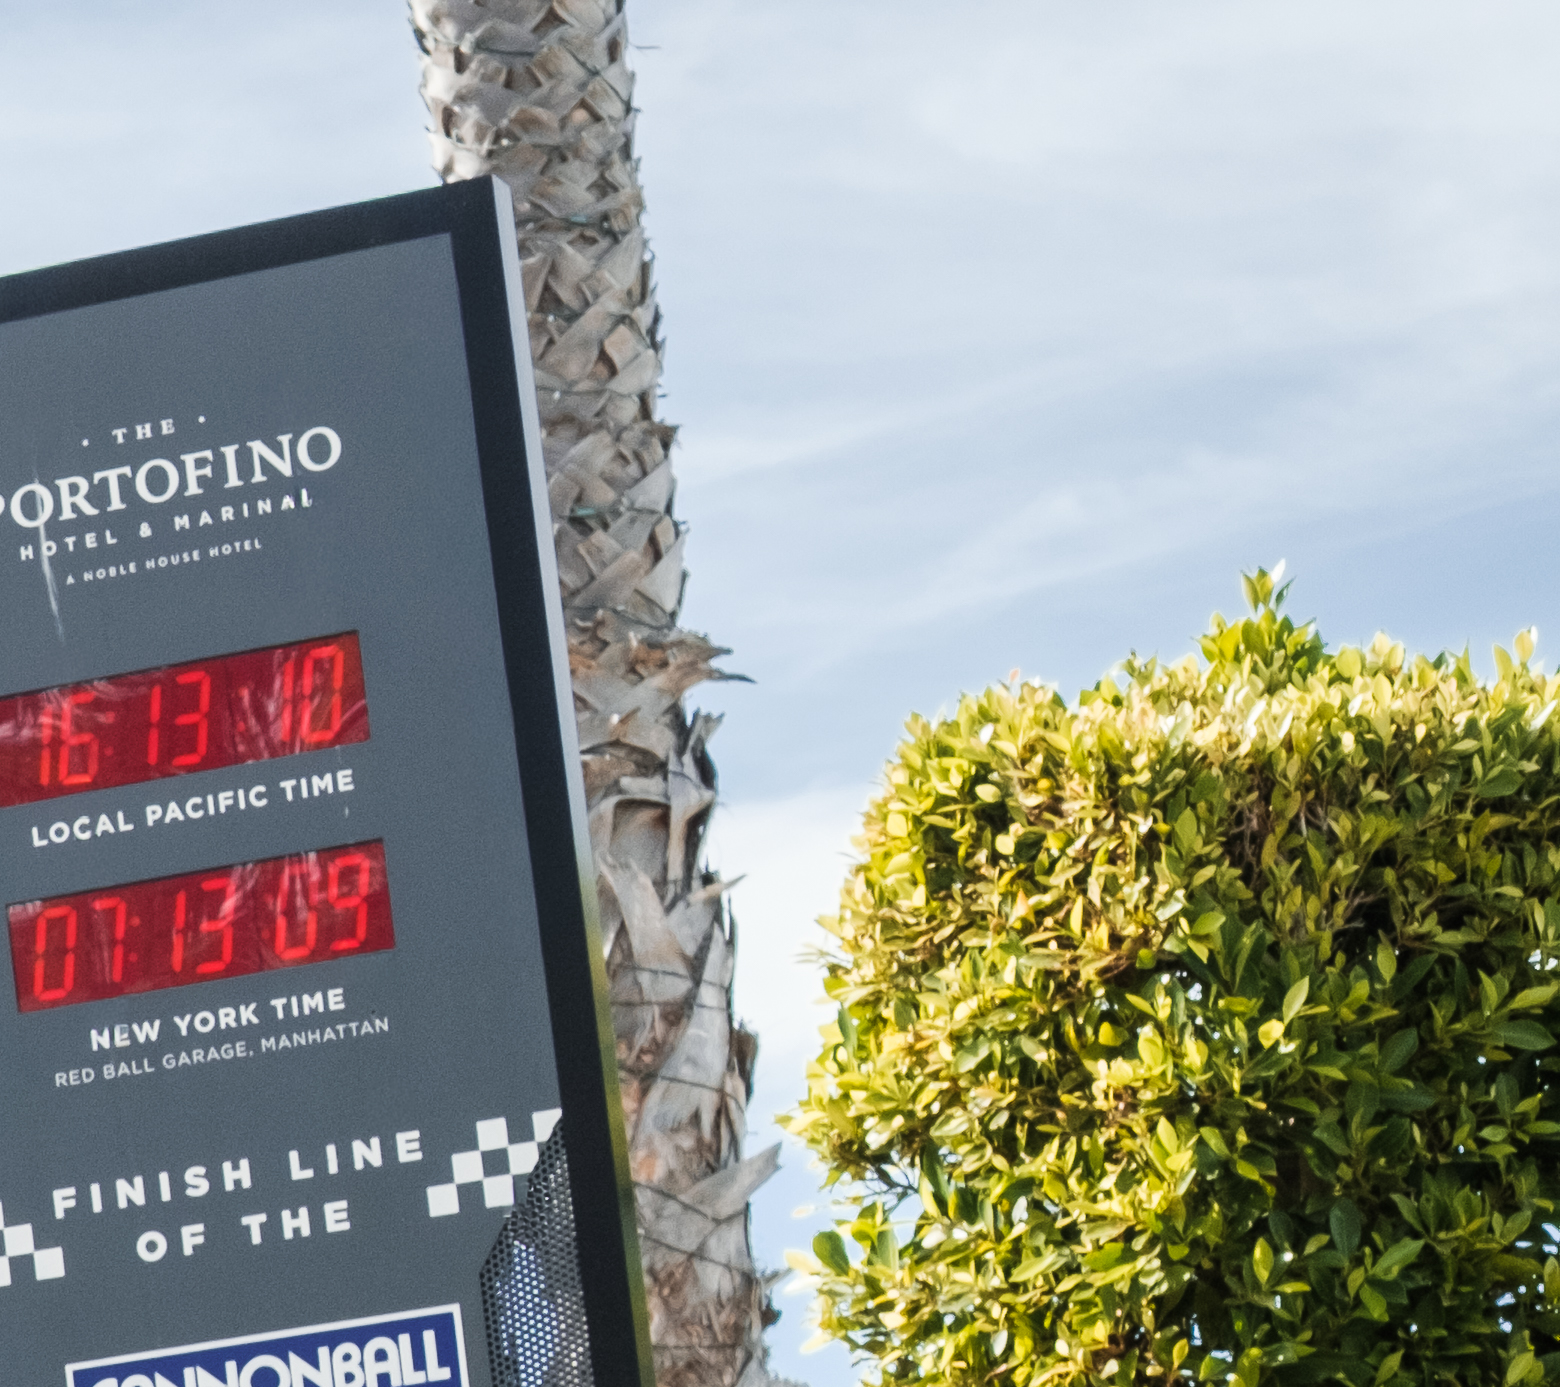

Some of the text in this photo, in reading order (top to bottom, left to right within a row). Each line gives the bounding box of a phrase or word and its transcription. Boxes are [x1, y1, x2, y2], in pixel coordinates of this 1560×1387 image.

[111, 418, 177, 445] THE
[19, 529, 119, 562] HOTEL
[138, 521, 153, 539] &
[65, 537, 263, 586] A NOBLE HOUSE HOTEL
[30, 768, 355, 848] LOCAL PACIFIC TIME
[54, 1016, 391, 1088] RED BALL GARAGE, MANHATTAN
[89, 987, 347, 1053] NEW YORK TIME
[51, 1129, 424, 1220] FINISH LINE
[135, 1199, 352, 1264] OF THE
